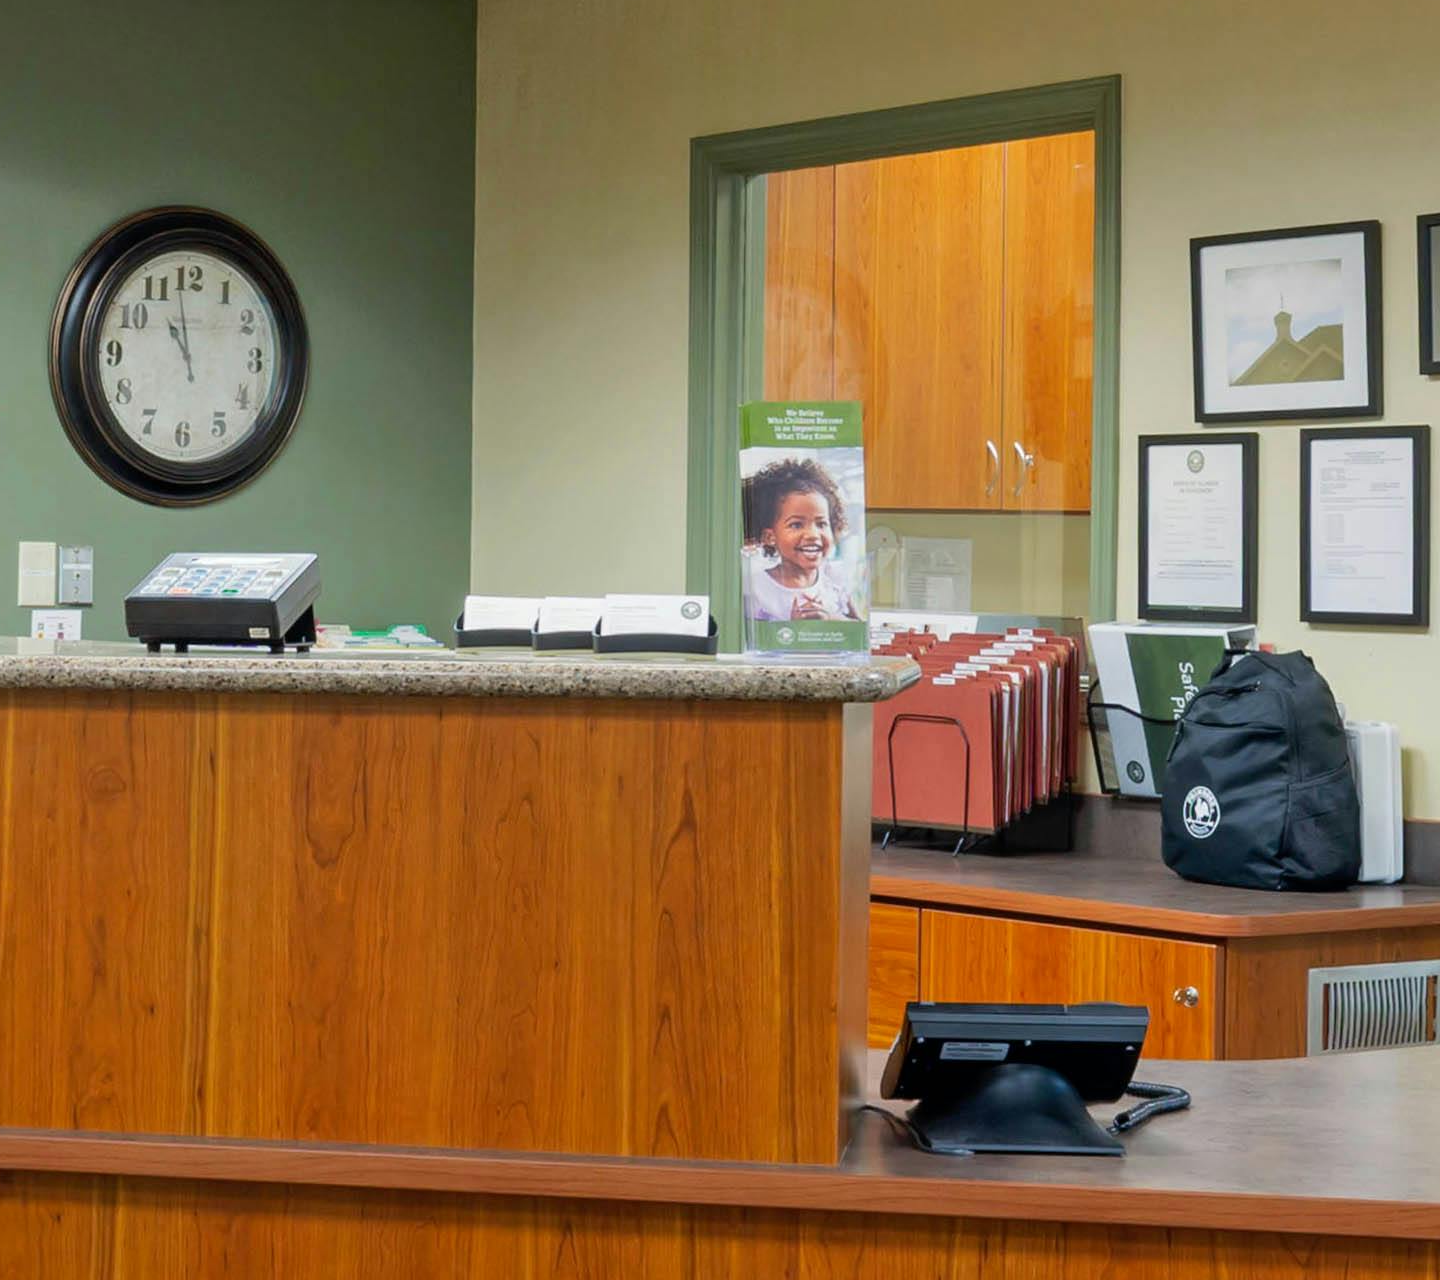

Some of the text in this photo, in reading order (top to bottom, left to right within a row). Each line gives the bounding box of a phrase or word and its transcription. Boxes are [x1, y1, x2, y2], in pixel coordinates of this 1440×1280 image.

[143, 276, 170, 301] 11
[175, 266, 204, 292] 12
[219, 280, 232, 305] 1
[118, 303, 148, 329] 10
[240, 309, 255, 335] 2
[106, 340, 123, 367] 9
[247, 347, 263, 374] 3
[116, 378, 132, 404] 8
[235, 382, 250, 410] 4
[141, 409, 157, 435] 7
[175, 421, 190, 448] 6
[211, 412, 227, 437] 5
[1178, 661, 1200, 702] Safe
